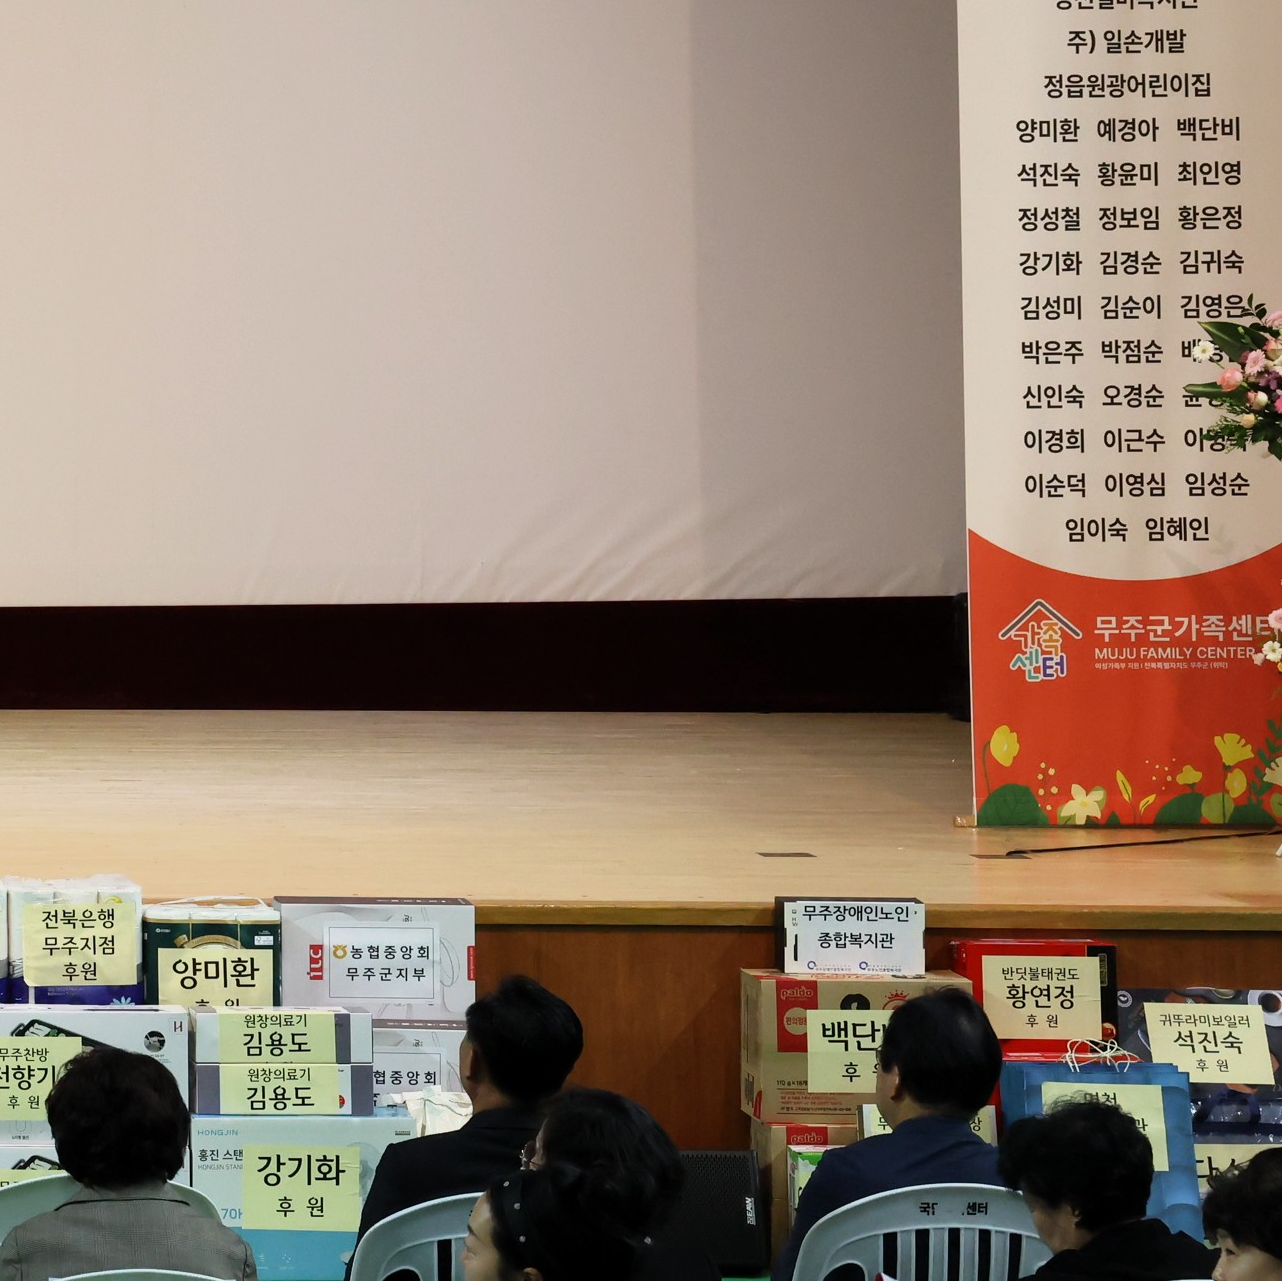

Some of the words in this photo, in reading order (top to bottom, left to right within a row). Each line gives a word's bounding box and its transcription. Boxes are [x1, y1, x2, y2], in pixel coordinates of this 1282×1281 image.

[1066, 29, 1096, 55] 주)
[1103, 28, 1187, 54] 일손개발
[1043, 72, 1211, 99] 정읍원광어린이집
[1015, 117, 1081, 144] 양미환
[1097, 117, 1160, 143] 예경아
[1176, 116, 1240, 142] 백단비
[1017, 162, 1081, 188] 석진숙
[1097, 161, 1159, 187] 황윤미
[1177, 160, 1241, 186] 최인영
[1018, 206, 1081, 232] 정성철
[1098, 205, 1160, 231] 정보임
[1177, 204, 1242, 231] 황은정
[1019, 250, 1083, 277] 강기화
[1099, 250, 1162, 276] 김경순
[1179, 249, 1245, 275] 김귀숙
[1020, 295, 1082, 321] 김성미
[1100, 294, 1162, 320] 김순이
[1180, 293, 1245, 319] 김영은
[1021, 339, 1085, 365] 박은주
[1101, 339, 1164, 365] 박점순
[1022, 384, 1085, 409] 신인숙
[1102, 383, 1165, 409] 오경순
[1023, 428, 1085, 454] 이경희
[1103, 427, 1166, 453] 이근수
[1024, 472, 1086, 499] 이순덕
[1104, 472, 1166, 498] 이영심
[1185, 471, 1251, 497] 임성순
[1065, 517, 1129, 543] 임이숙
[1145, 516, 1210, 542] 임혜인
[802, 905, 909, 923] 무주장애인노인
[817, 931, 896, 950] 종합복지관
[172, 956, 260, 990] 양미환
[1001, 966, 1080, 982] 반딧불태권도
[1005, 983, 1075, 1010] 황연정
[243, 1013, 307, 1029] 원창의료기
[1159, 1013, 1251, 1029] 귀뚜라미보일러
[243, 1030, 312, 1057] 김용도
[1173, 1029, 1244, 1055] 석진숙
[256, 1153, 346, 1187] 강기화
